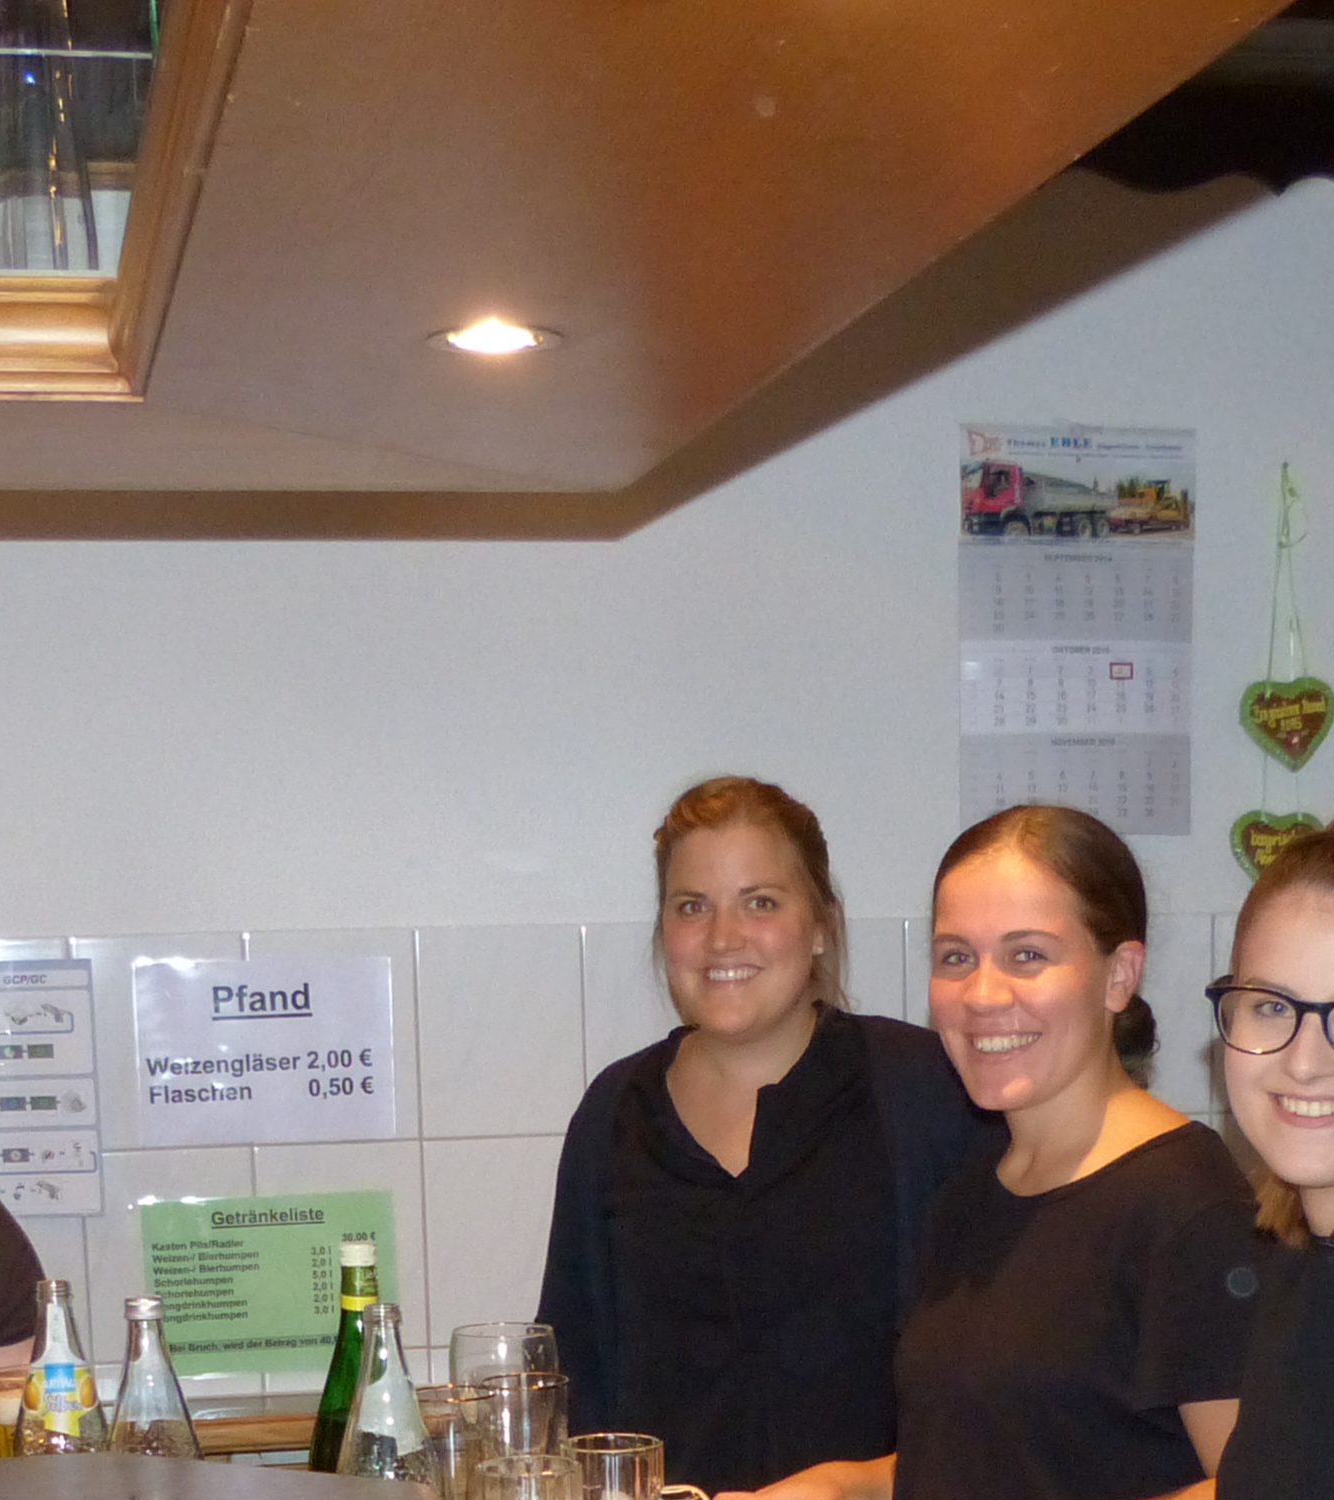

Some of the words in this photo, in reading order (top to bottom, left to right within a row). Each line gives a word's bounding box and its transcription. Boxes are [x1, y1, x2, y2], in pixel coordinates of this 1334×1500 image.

[3, 974, 48, 985] GCP/GC
[212, 982, 312, 1014] Pfand
[146, 1053, 301, 1078] Weizengläser
[307, 1049, 353, 1072] 2,00
[359, 1048, 374, 1067] €
[148, 1083, 253, 1104] Flaschen
[308, 1076, 354, 1099] 0,50
[361, 1076, 375, 1095] €
[211, 1208, 326, 1226] Getränkeliste
[152, 1242, 187, 1252] Kasten
[190, 1239, 245, 1250] Pils/Radler
[199, 1250, 260, 1263] Bierhumpen
[199, 1262, 260, 1275] Bierhumpen
[154, 1275, 233, 1288] Schorlehumpen
[163, 1299, 248, 1313] ongdrinkhumpen
[163, 1310, 249, 1325] ongdrinkhumpen
[223, 1341, 245, 1350] wird
[246, 1340, 263, 1348] der
[265, 1338, 297, 1349] Betrag
